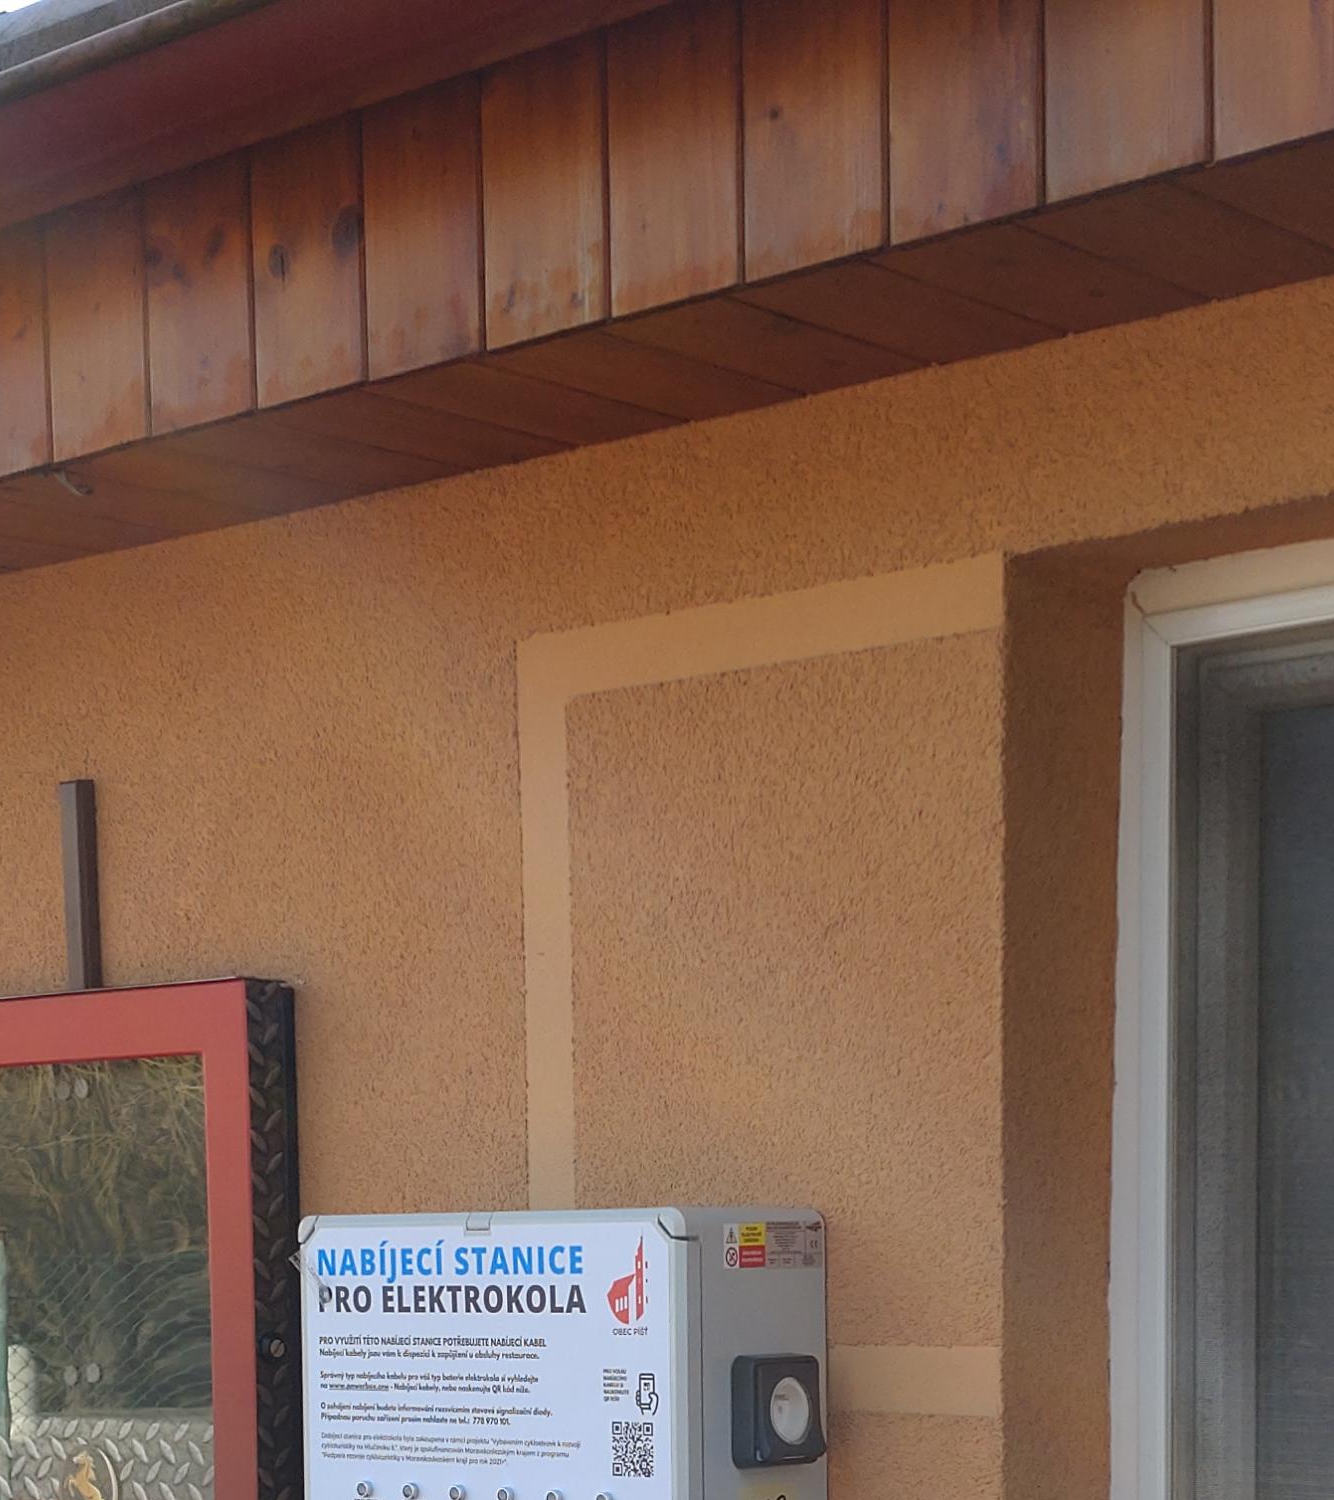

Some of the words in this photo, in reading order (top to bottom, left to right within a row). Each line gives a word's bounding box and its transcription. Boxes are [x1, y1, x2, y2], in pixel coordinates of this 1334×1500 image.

[318, 1239, 444, 1284] NABÍJECÍ
[454, 1245, 583, 1276] STANICE
[318, 1284, 372, 1313] PRO
[382, 1284, 587, 1314] ELEKTROKOLA
[612, 1328, 632, 1336] OBEC
[319, 1336, 333, 1345] PRO
[334, 1334, 362, 1345] VYUŽITÍ
[363, 1335, 379, 1345] TÉTO
[381, 1335, 411, 1346] NABÍJECÍ
[412, 1337, 441, 1346] STANICE
[443, 1335, 489, 1347] POTŘEBUJETE
[490, 1336, 522, 1347] NABÍJECÍ
[524, 1338, 546, 1347] KABEL
[492, 1385, 501, 1393] QR
[473, 1417, 485, 1425] 778
[486, 1417, 498, 1425] 970
